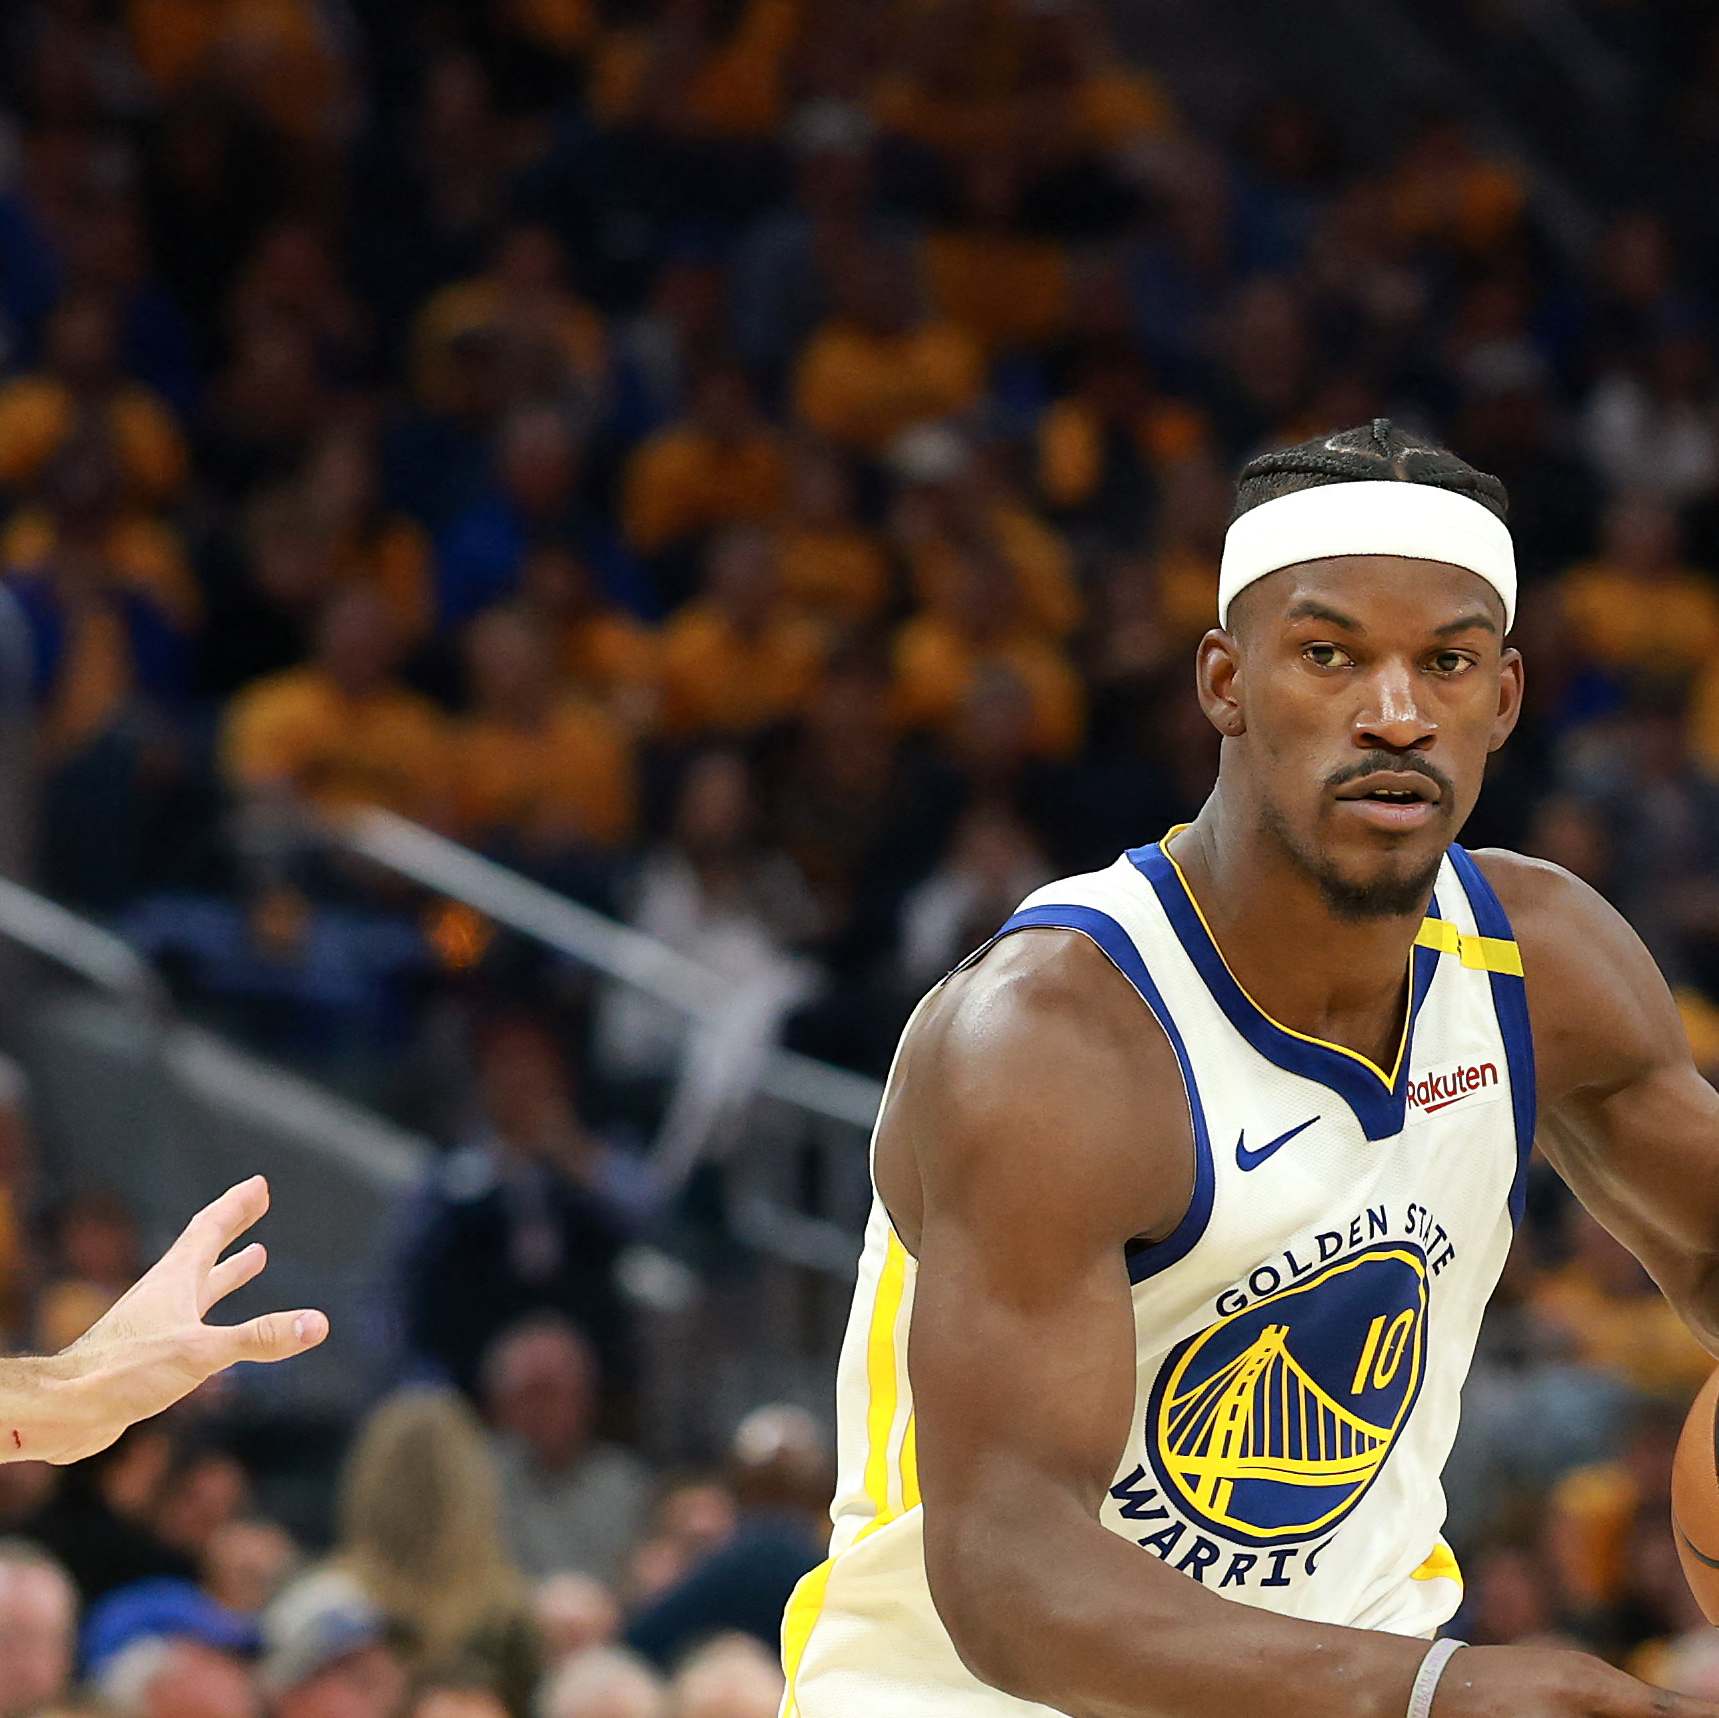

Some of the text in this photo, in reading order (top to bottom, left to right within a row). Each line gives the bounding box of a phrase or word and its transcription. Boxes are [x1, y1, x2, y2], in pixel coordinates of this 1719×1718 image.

[1406, 1063, 1499, 1110] Rakuten
[1215, 1202, 1456, 1318] GOLDEN STATE
[1350, 1309, 1415, 1395] 10
